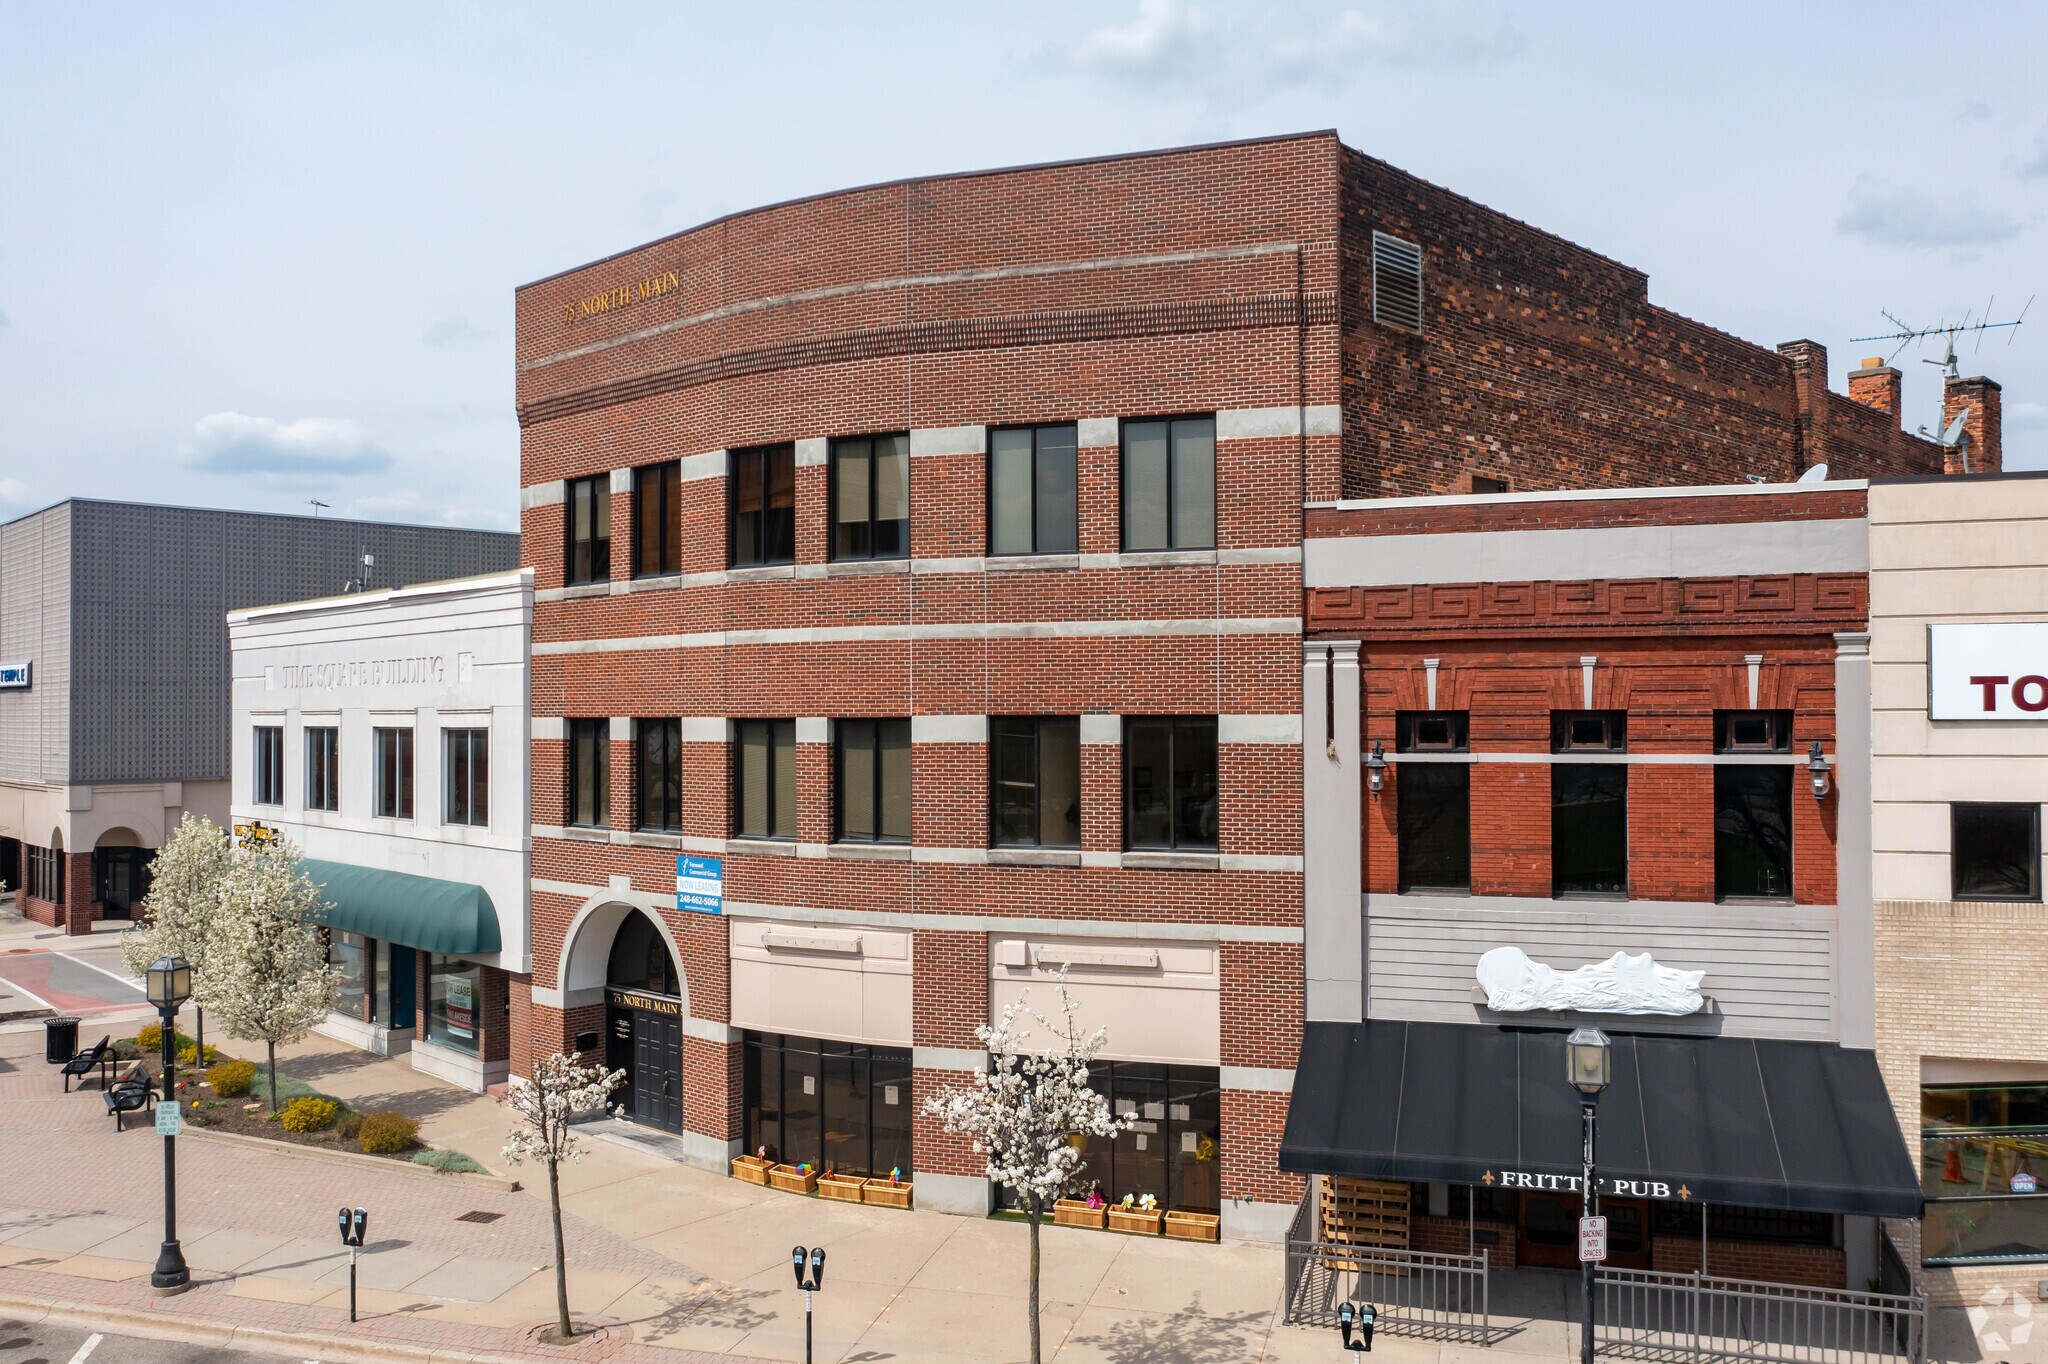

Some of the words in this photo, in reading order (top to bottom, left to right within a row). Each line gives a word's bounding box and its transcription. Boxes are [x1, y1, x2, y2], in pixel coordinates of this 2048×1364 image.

[563, 303, 576, 321] 75
[581, 284, 631, 317] NORTH
[638, 270, 680, 300] MAIN
[283, 665, 312, 688] TIME
[317, 662, 367, 692] SQUARE
[372, 656, 443, 685] BUILDING
[1969, 674, 2048, 712] TO
[680, 880, 694, 890] NOW
[695, 881, 719, 893] LEASING
[680, 894, 719, 907] 248-662-5066
[454, 987, 471, 997] LEASE
[613, 993, 621, 1003] 75
[624, 995, 651, 1009] NORTH
[653, 1001, 677, 1014] MAIN
[1500, 1171, 1604, 1191] FRITT'
[1613, 1179, 1670, 1197] PUB
[2014, 1182, 2033, 1190] OPEN
[1589, 1220, 1597, 1228] NO
[1582, 1229, 1604, 1238] BACKING
[1587, 1239, 1599, 1248] INTO
[1583, 1249, 1602, 1257] SPACES
